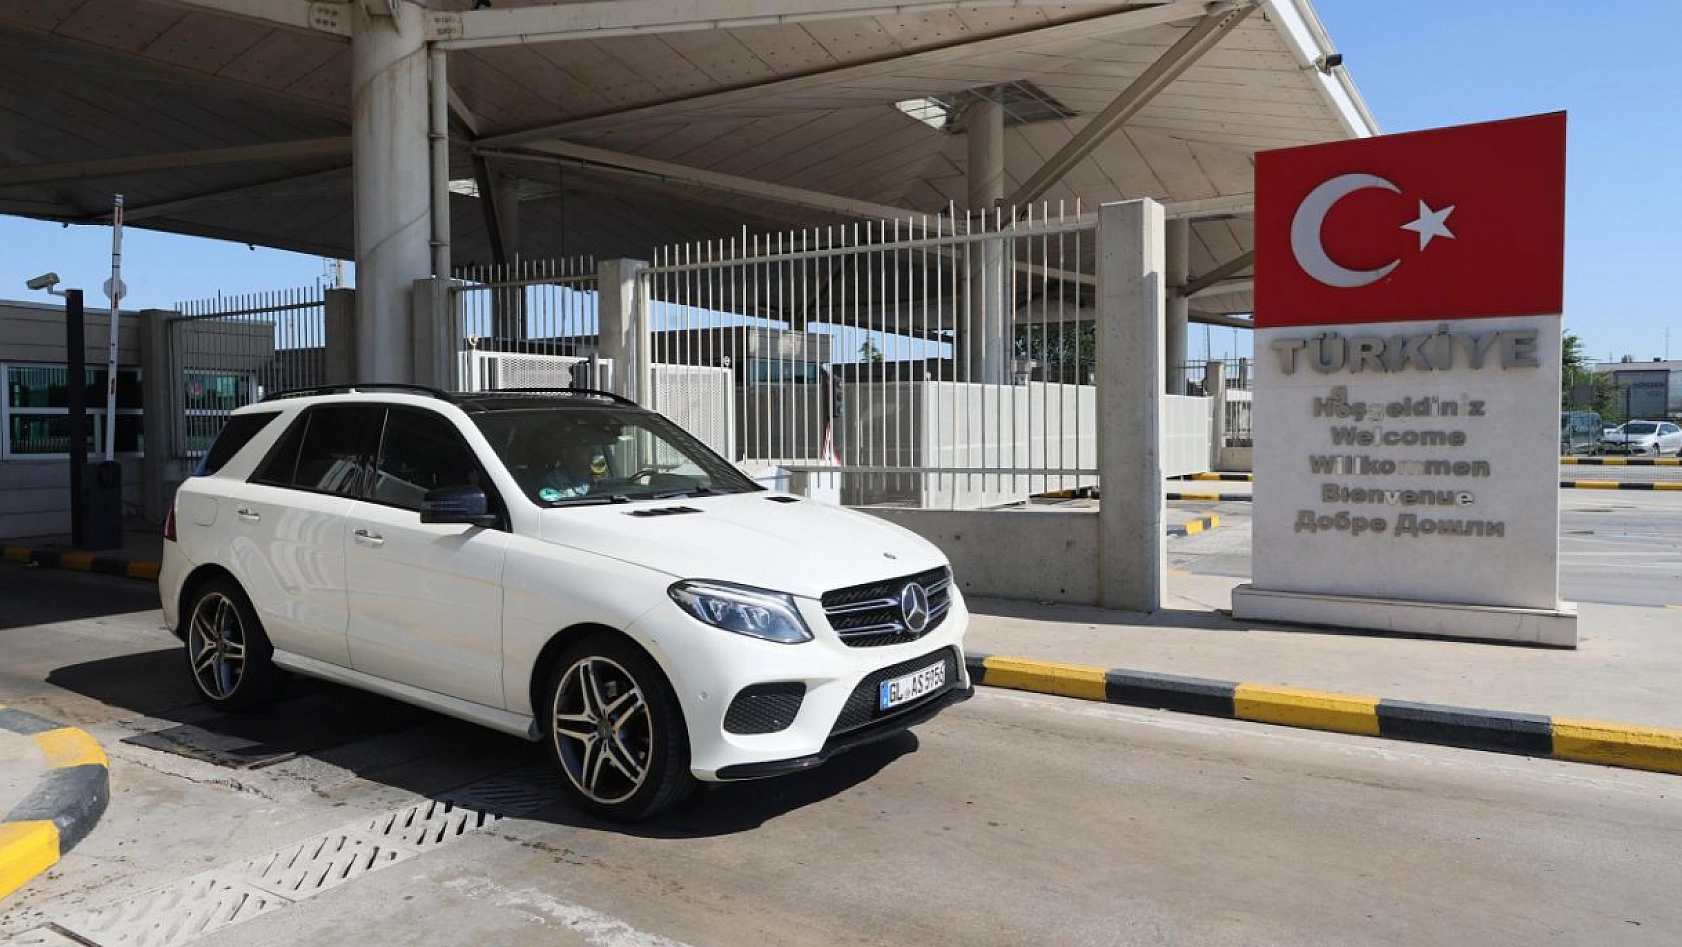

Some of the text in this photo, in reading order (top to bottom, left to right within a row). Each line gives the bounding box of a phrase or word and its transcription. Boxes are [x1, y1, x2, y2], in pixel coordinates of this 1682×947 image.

[1272, 323, 1541, 375] TÜRKİYE
[1330, 427, 1468, 447] Welcome
[1309, 454, 1491, 477] Willkommen
[1321, 483, 1475, 505] Bienvenue
[1293, 510, 1506, 538] Добре Дошли
